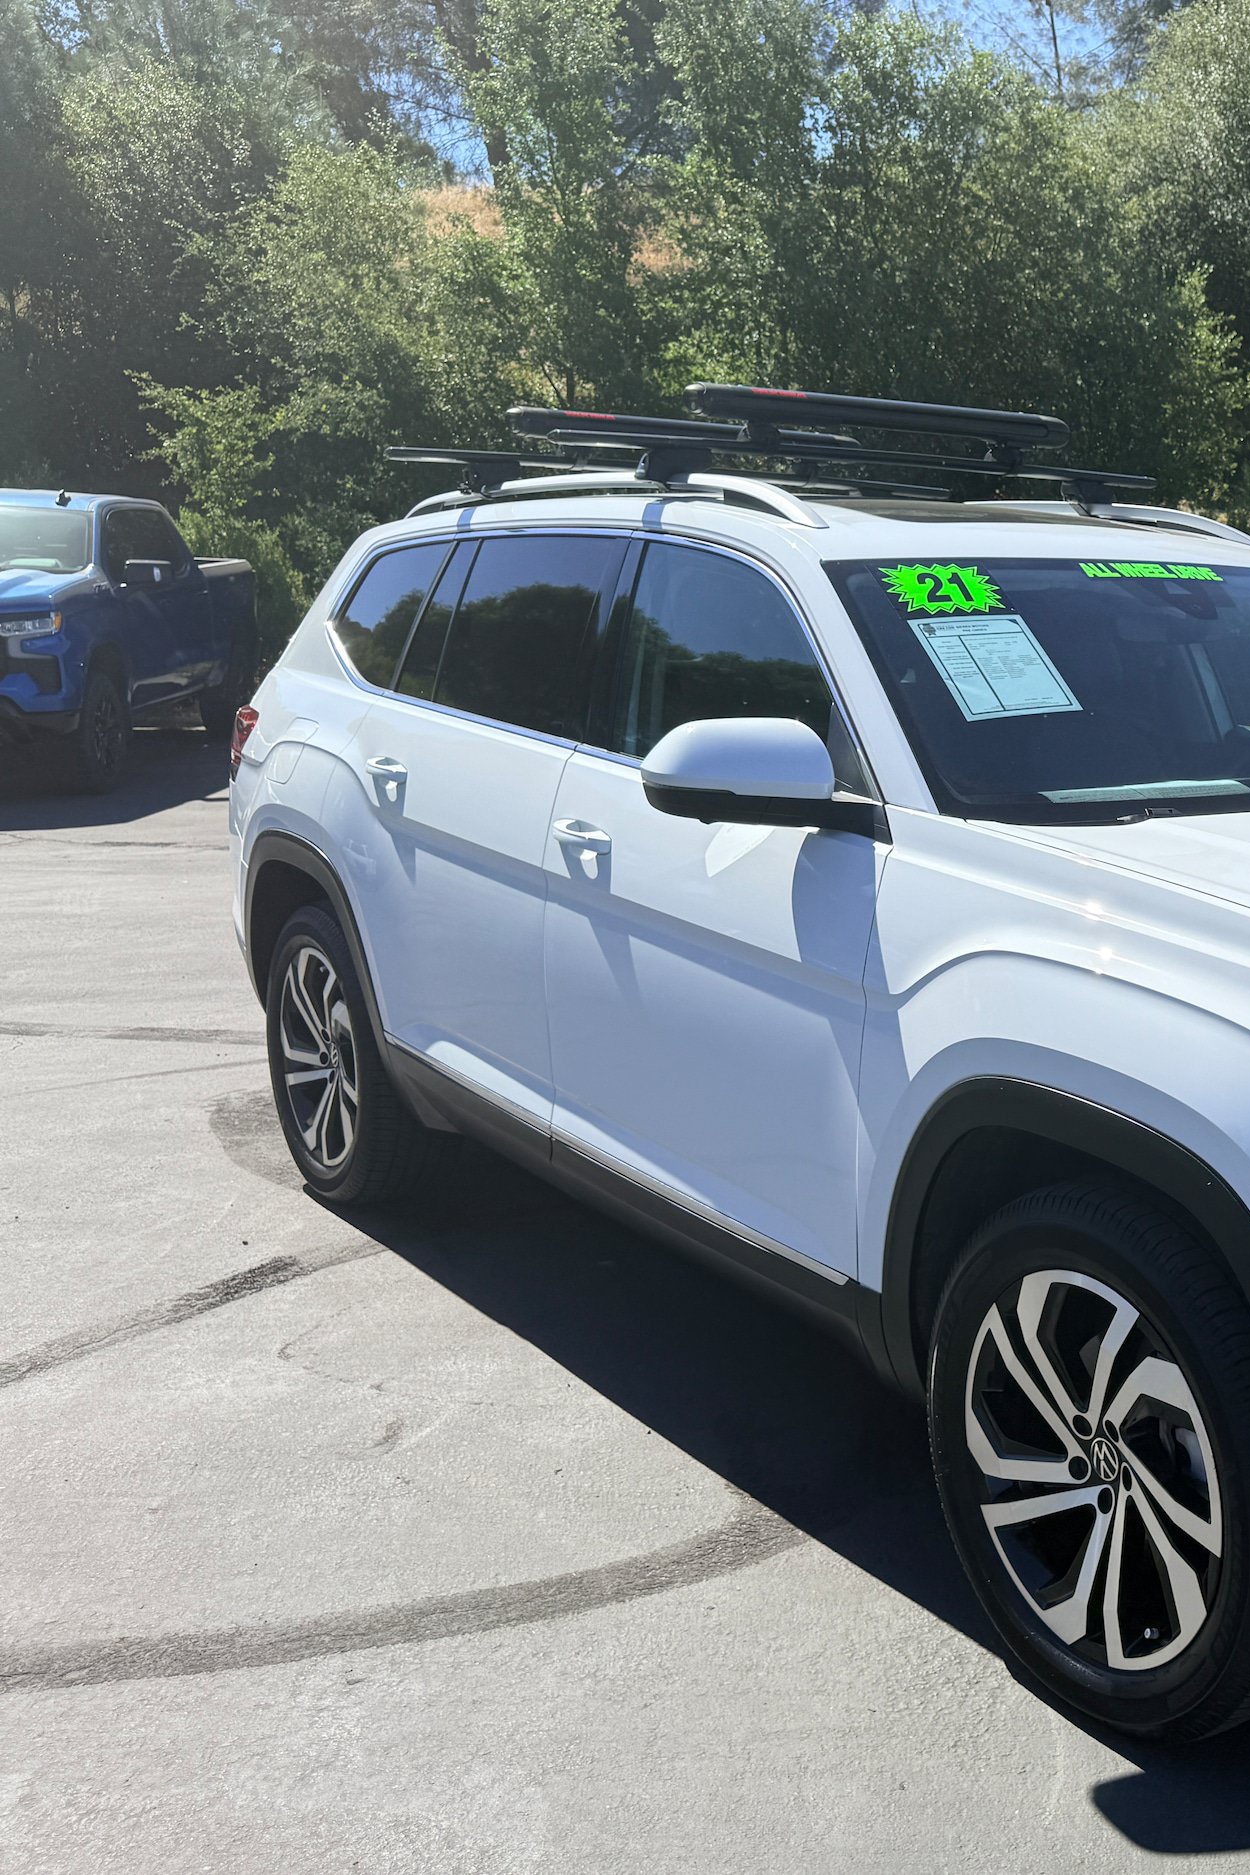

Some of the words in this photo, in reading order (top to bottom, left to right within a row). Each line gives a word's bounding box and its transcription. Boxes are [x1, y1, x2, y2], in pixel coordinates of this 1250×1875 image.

[1078, 562, 1122, 578] ALL
[1108, 562, 1179, 579] WHEEL
[1166, 564, 1224, 582] DRIVE
[916, 572, 975, 603] 21
